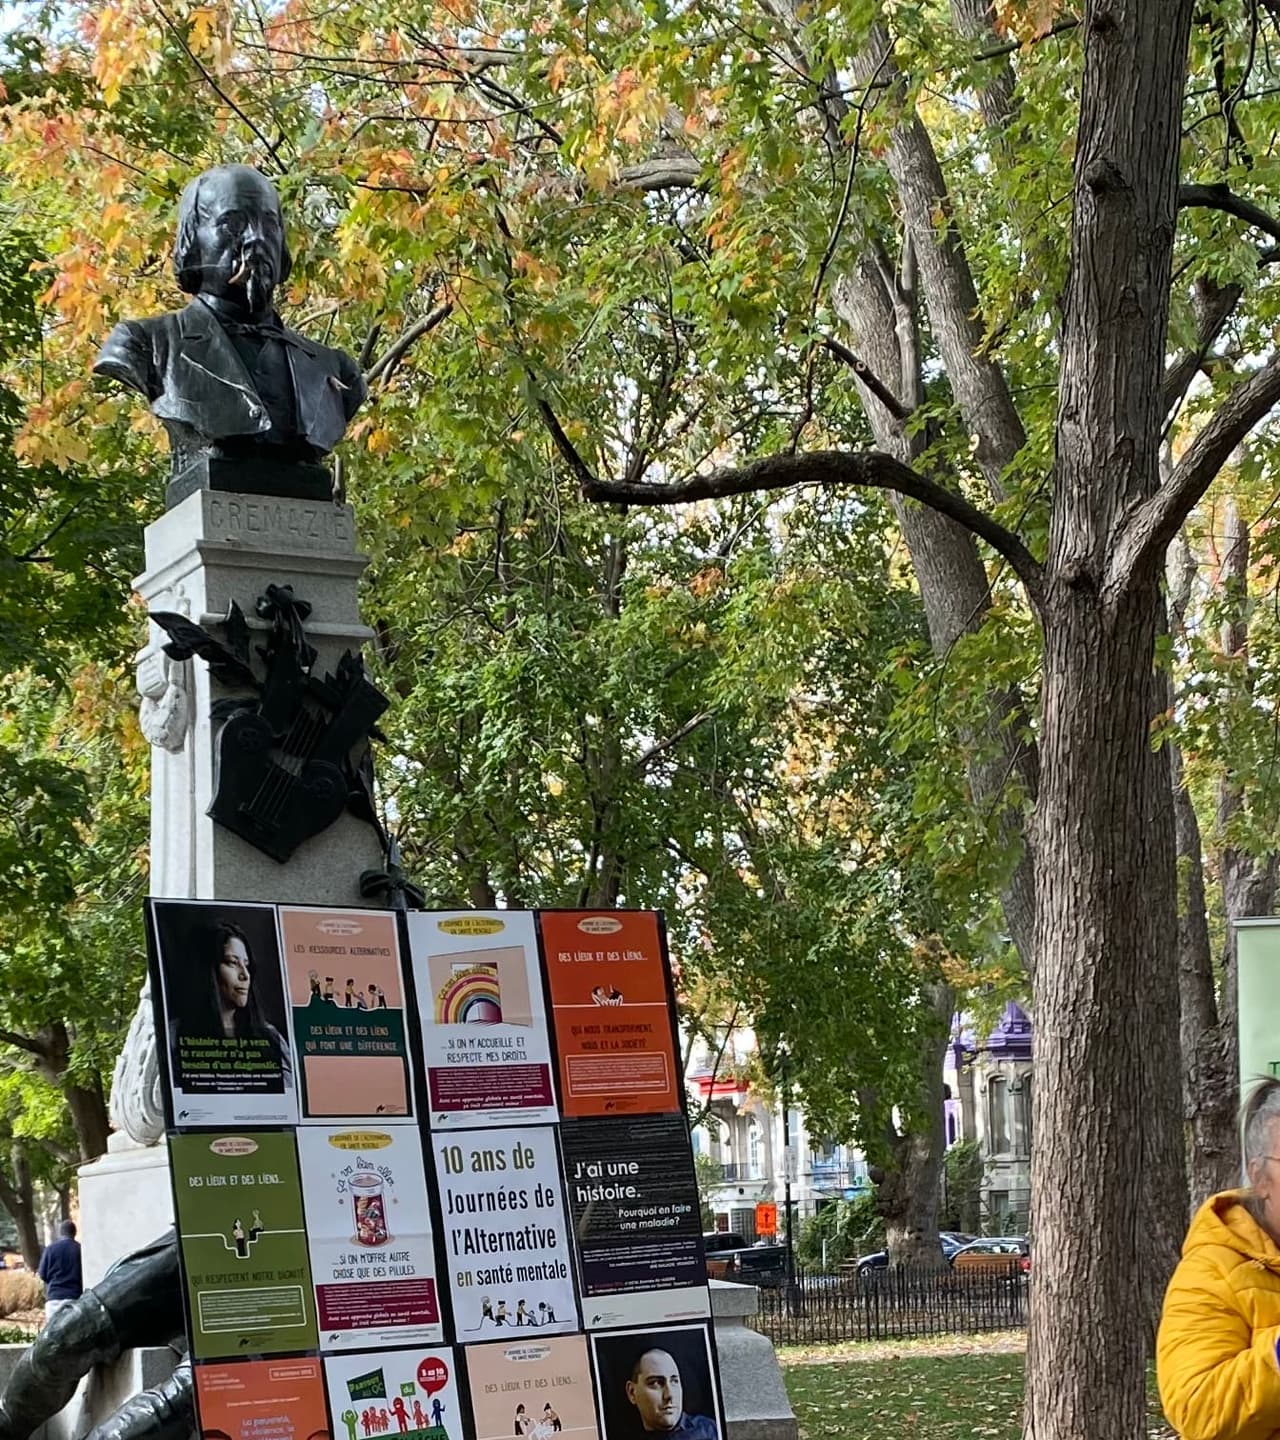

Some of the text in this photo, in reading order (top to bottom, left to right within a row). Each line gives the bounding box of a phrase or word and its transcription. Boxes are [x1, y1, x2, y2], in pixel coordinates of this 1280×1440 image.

[457, 1038, 466, 1048] ON
[517, 1037, 525, 1047] ET
[447, 1050, 527, 1063] RESPECTE MES DROITS
[440, 1141, 535, 1174] 10 ans de
[574, 1161, 640, 1179] J'ai une
[189, 1176, 204, 1187] DES
[229, 1175, 238, 1186] ET
[241, 1174, 255, 1185] DES
[447, 1182, 555, 1215] Journées de
[576, 1183, 642, 1203] histoire.
[619, 1204, 692, 1219] Pourquoi en faire
[620, 1216, 680, 1230] une maladie?
[452, 1223, 557, 1256] l'Alternative
[348, 1254, 358, 1265] ON
[389, 1251, 410, 1262] AUTRE
[333, 1265, 416, 1279] CHOSE QUE DES PILULES
[456, 1269, 473, 1287] en
[477, 1263, 513, 1285] santé
[516, 1259, 568, 1282] mentale
[485, 1383, 498, 1393] DES
[524, 1380, 532, 1390] ET
[534, 1378, 548, 1389] DES
